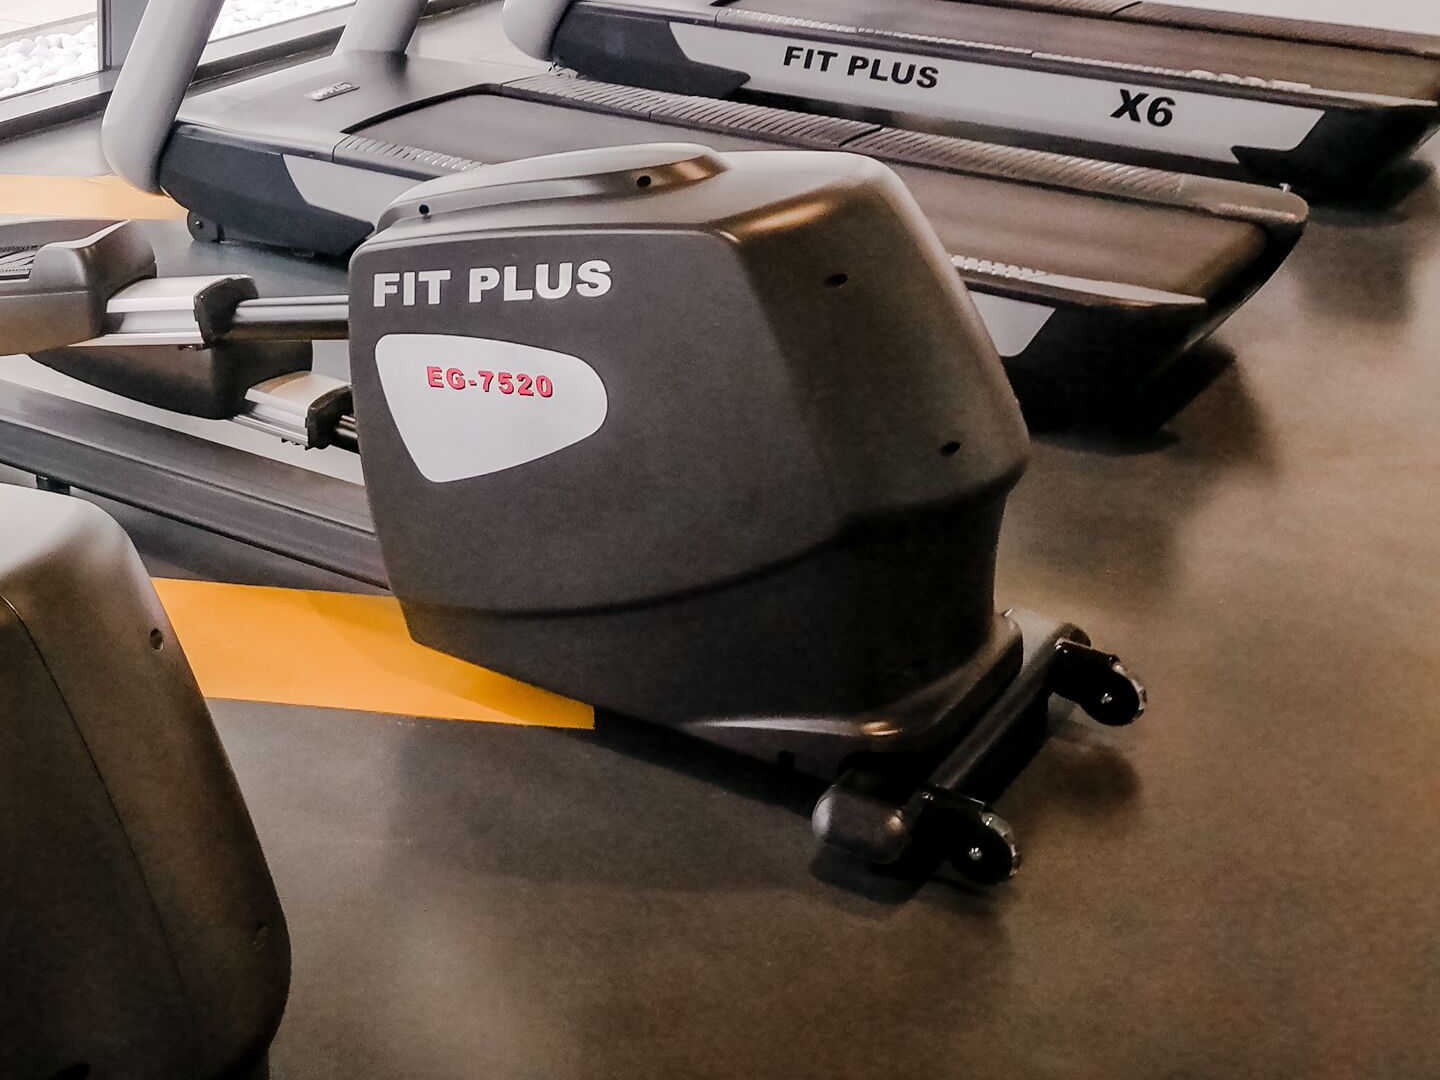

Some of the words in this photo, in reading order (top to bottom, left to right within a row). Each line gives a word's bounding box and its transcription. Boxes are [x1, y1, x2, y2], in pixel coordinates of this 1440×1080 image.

[783, 45, 838, 72] FIT
[846, 54, 940, 89] PLUS
[1109, 88, 1177, 127] X6
[373, 270, 452, 307] FIT
[468, 259, 612, 304] PLUS
[426, 366, 554, 398] EG-7520
